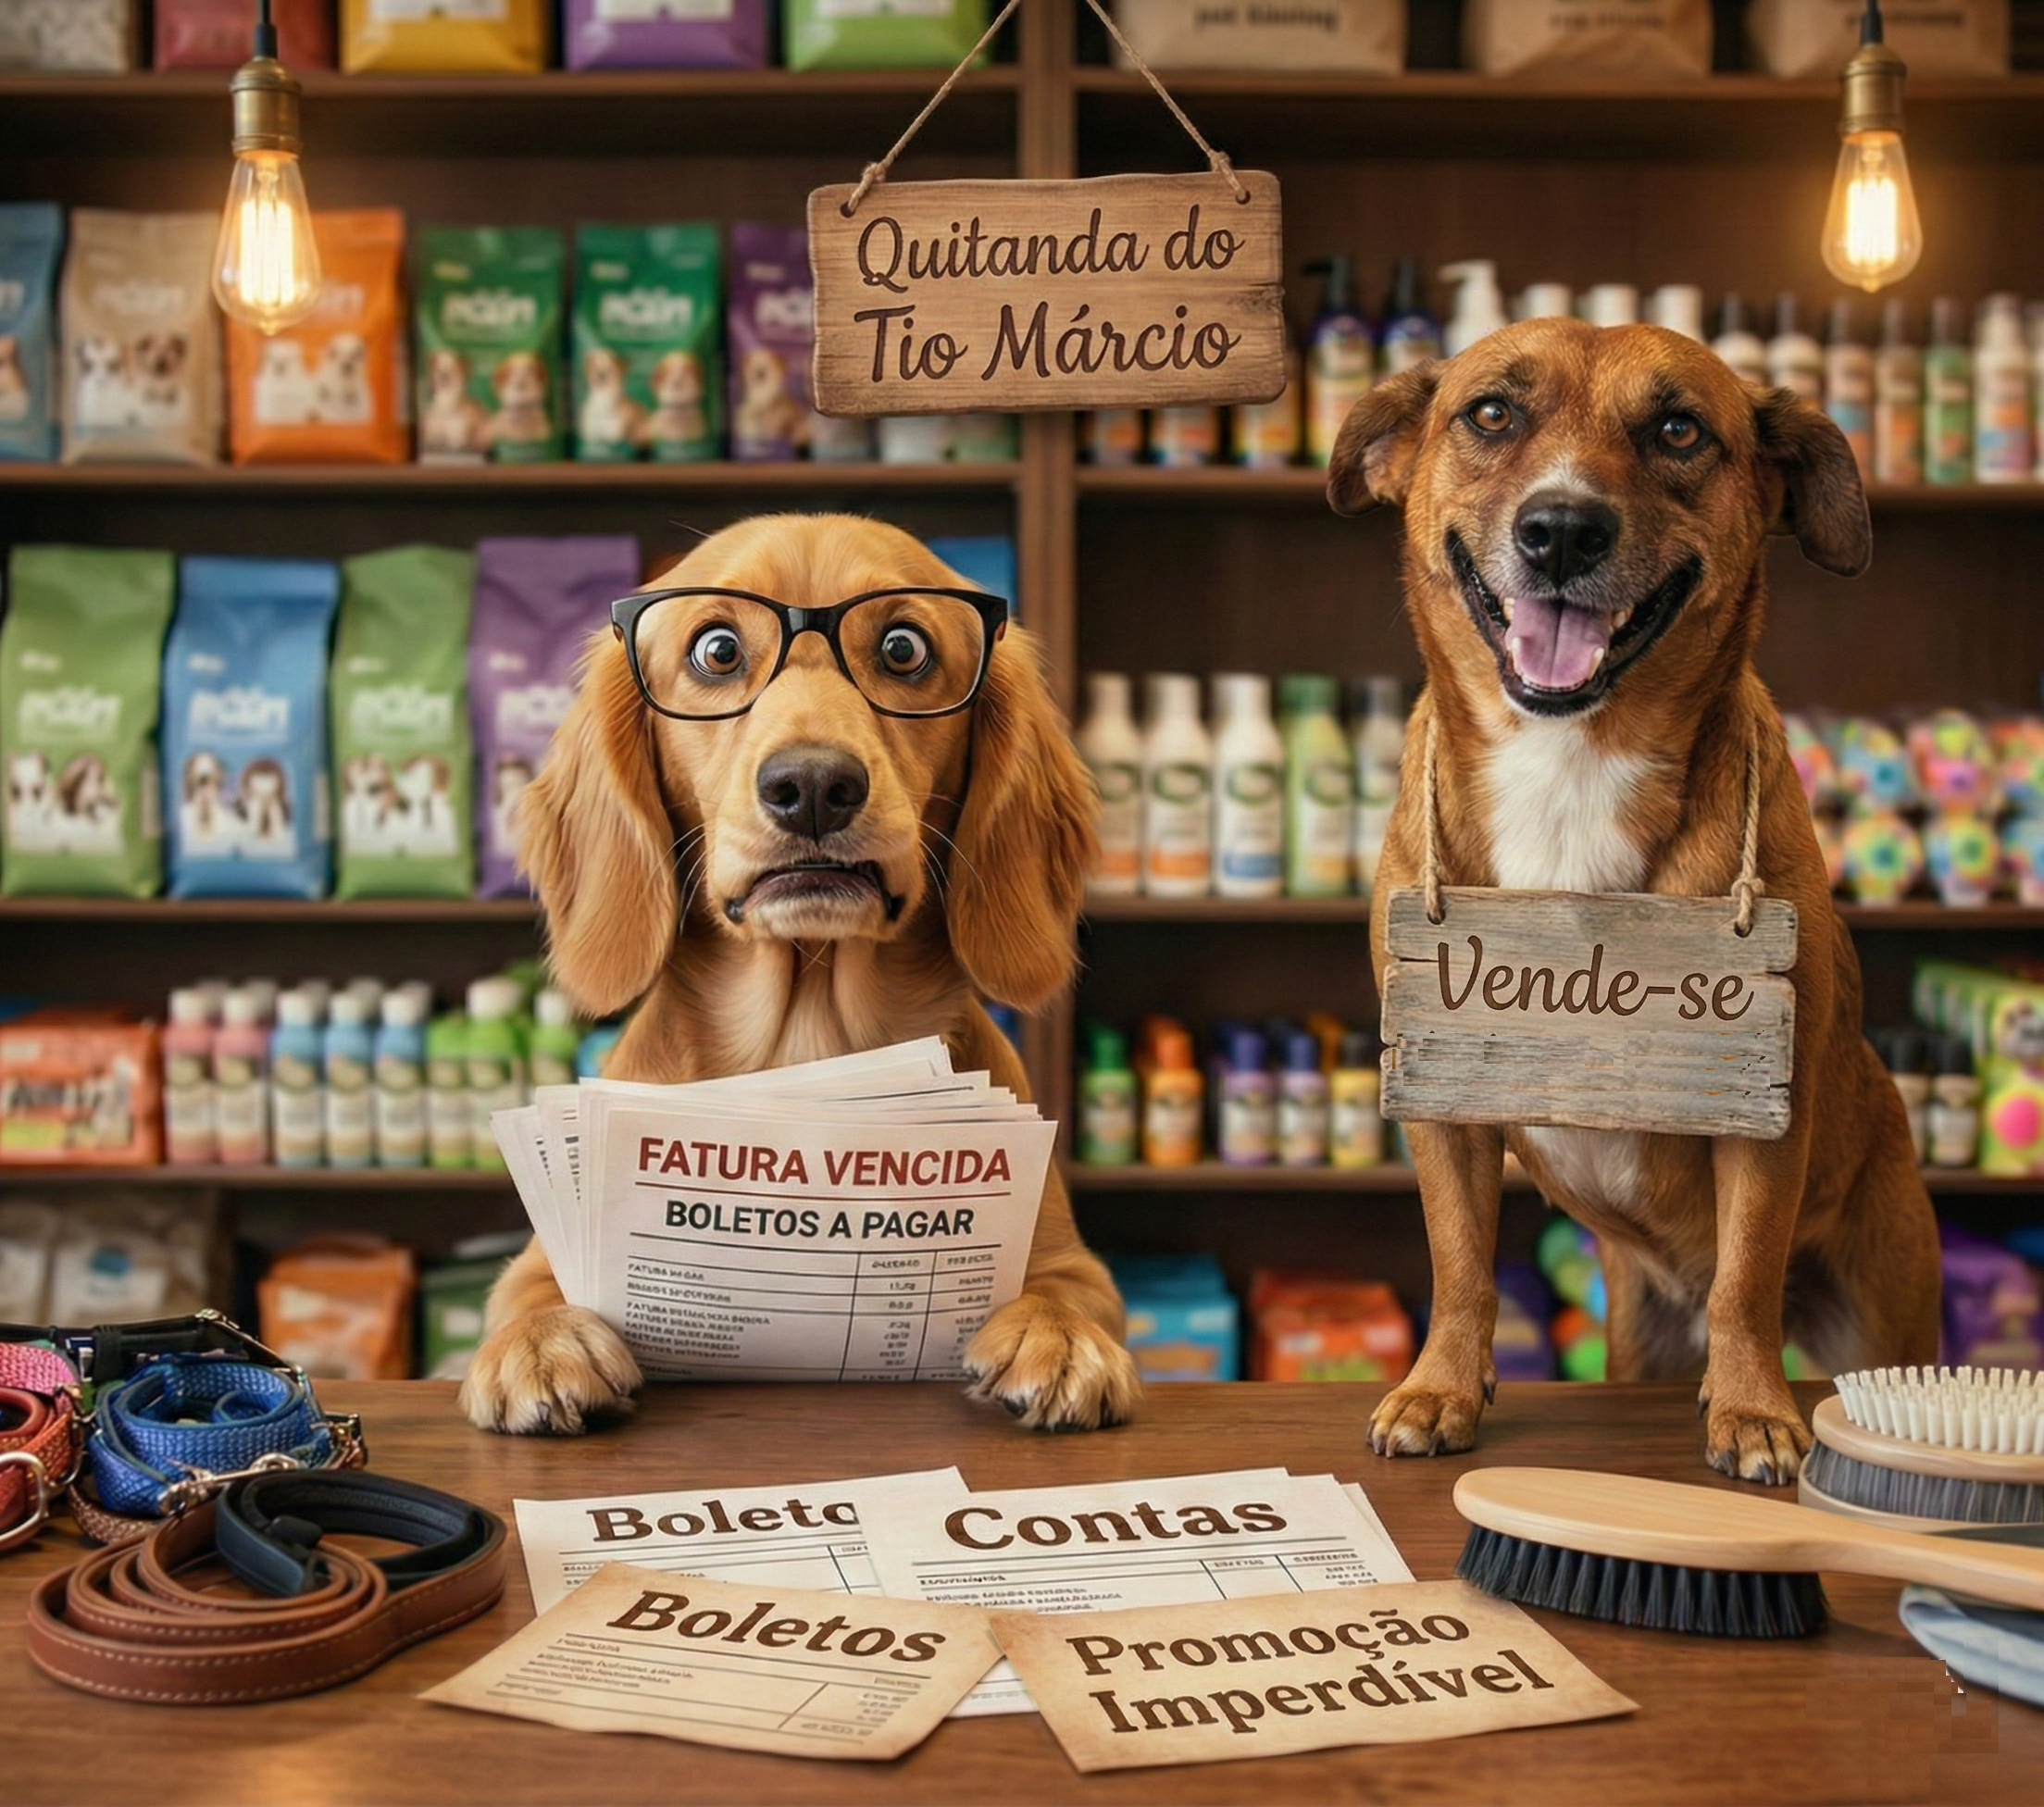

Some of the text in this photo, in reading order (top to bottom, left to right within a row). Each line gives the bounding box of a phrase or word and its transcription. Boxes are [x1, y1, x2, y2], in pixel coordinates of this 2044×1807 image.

[857, 204, 1245, 294] Quitanda do
[854, 304, 968, 383] Tio
[981, 301, 1242, 381] Márcio
[1437, 934, 1755, 1021] Vende-se
[639, 1137, 1011, 1186] FATURA VENCIDA
[666, 1200, 975, 1240] BOLETOS A PAGAR
[944, 1500, 1289, 1552] Contas
[605, 1589, 947, 1663] Boletos
[1065, 1608, 1470, 1677] Promoção
[1088, 1649, 1555, 1735] Imperdível
